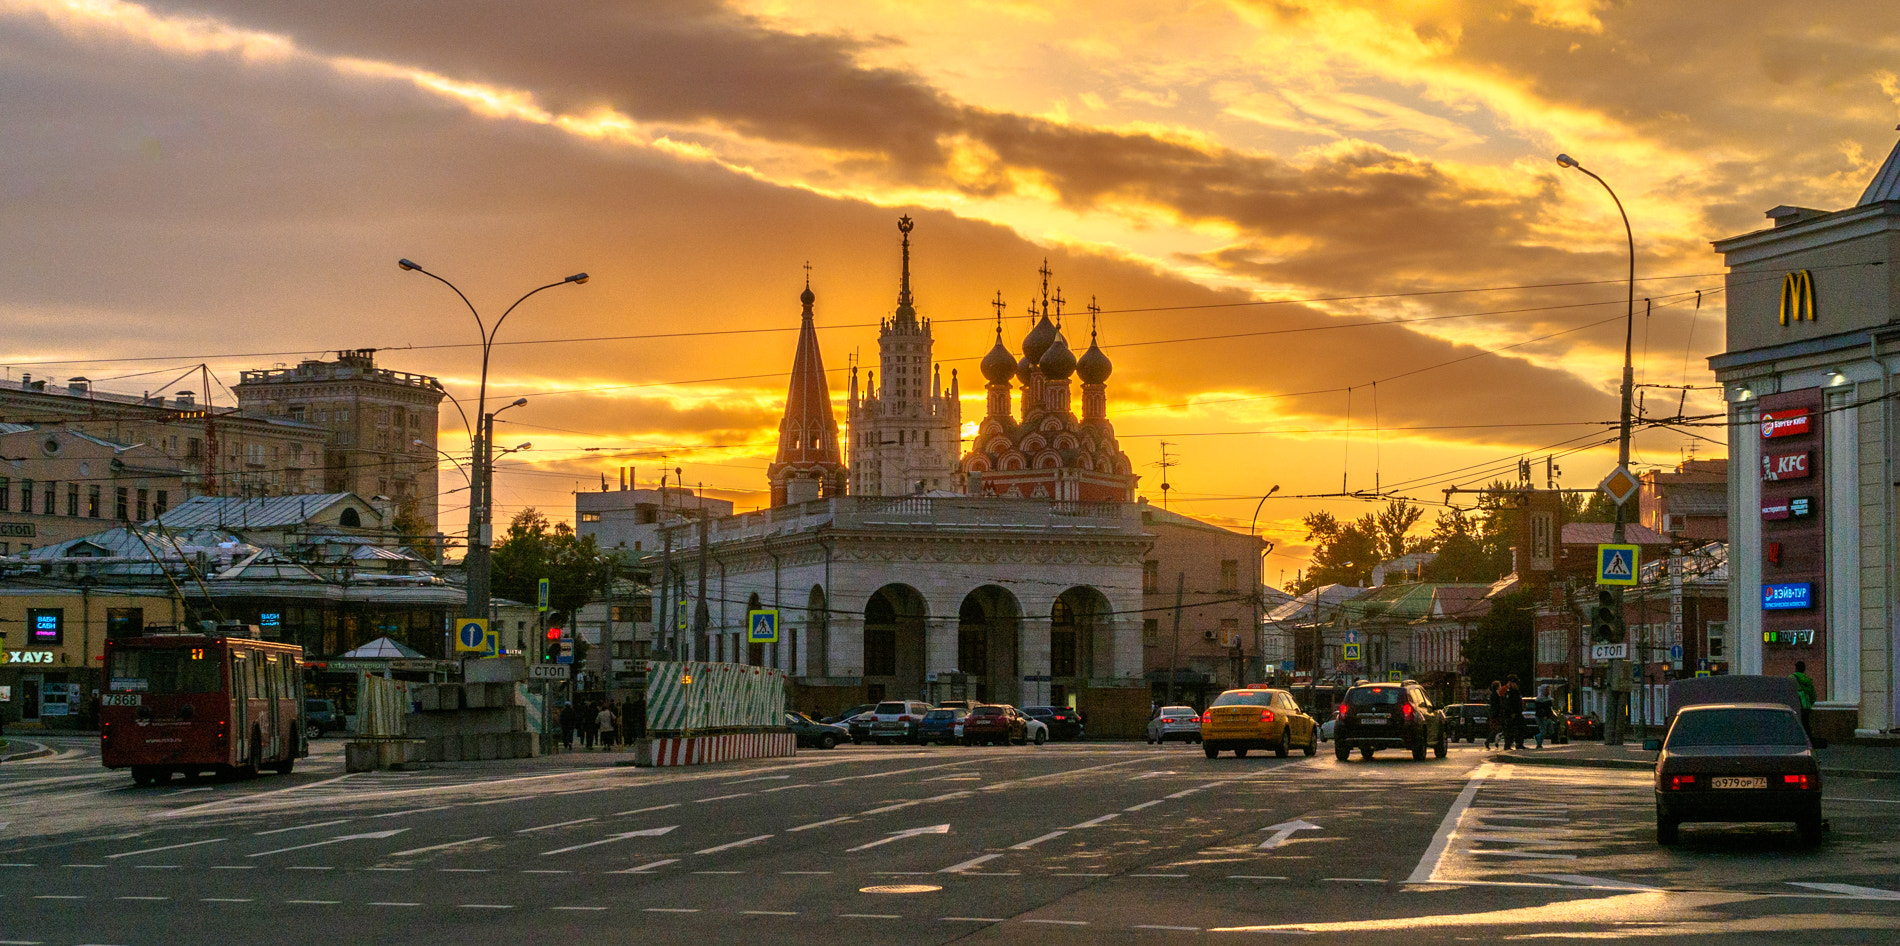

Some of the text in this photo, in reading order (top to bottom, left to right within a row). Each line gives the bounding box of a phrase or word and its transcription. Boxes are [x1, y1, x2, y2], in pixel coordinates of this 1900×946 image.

[1777, 454, 1806, 473] KFC
[9, 651, 54, 663] ХАУЗ
[1596, 645, 1622, 657] СТОП
[535, 666, 565, 676] СТОП
[107, 695, 137, 705] 7868
